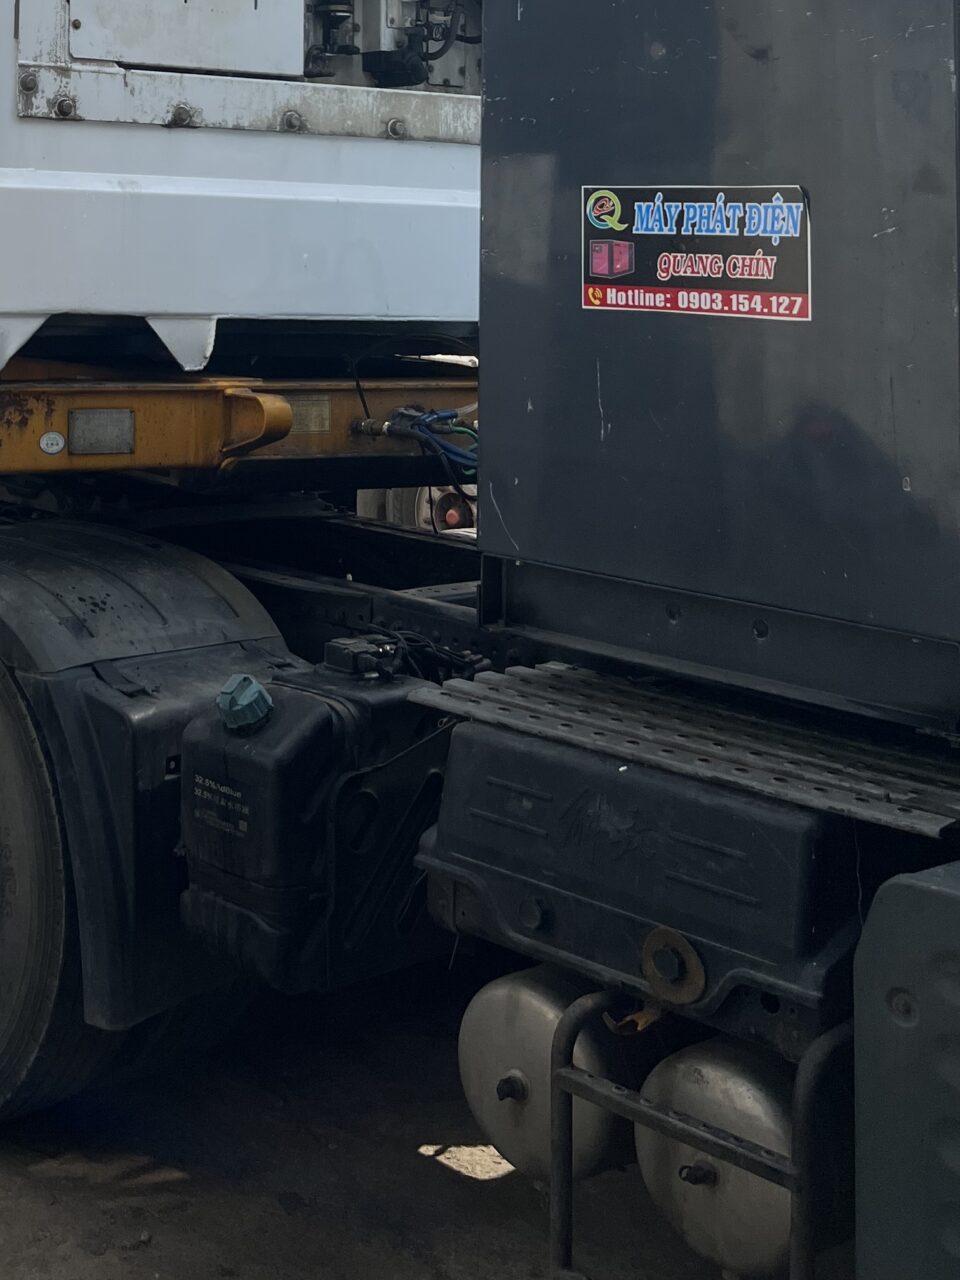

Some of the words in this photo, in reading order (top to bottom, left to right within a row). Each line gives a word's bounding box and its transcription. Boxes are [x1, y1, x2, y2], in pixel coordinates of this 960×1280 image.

[632, 192, 681, 235] MÁY
[681, 192, 743, 236] PHÁT
[744, 192, 804, 246] ĐIỆN
[657, 252, 723, 281] QUANG
[726, 249, 777, 280] CHÍN
[606, 287, 671, 308] Hotline:
[677, 290, 804, 315] 0903.154.127
